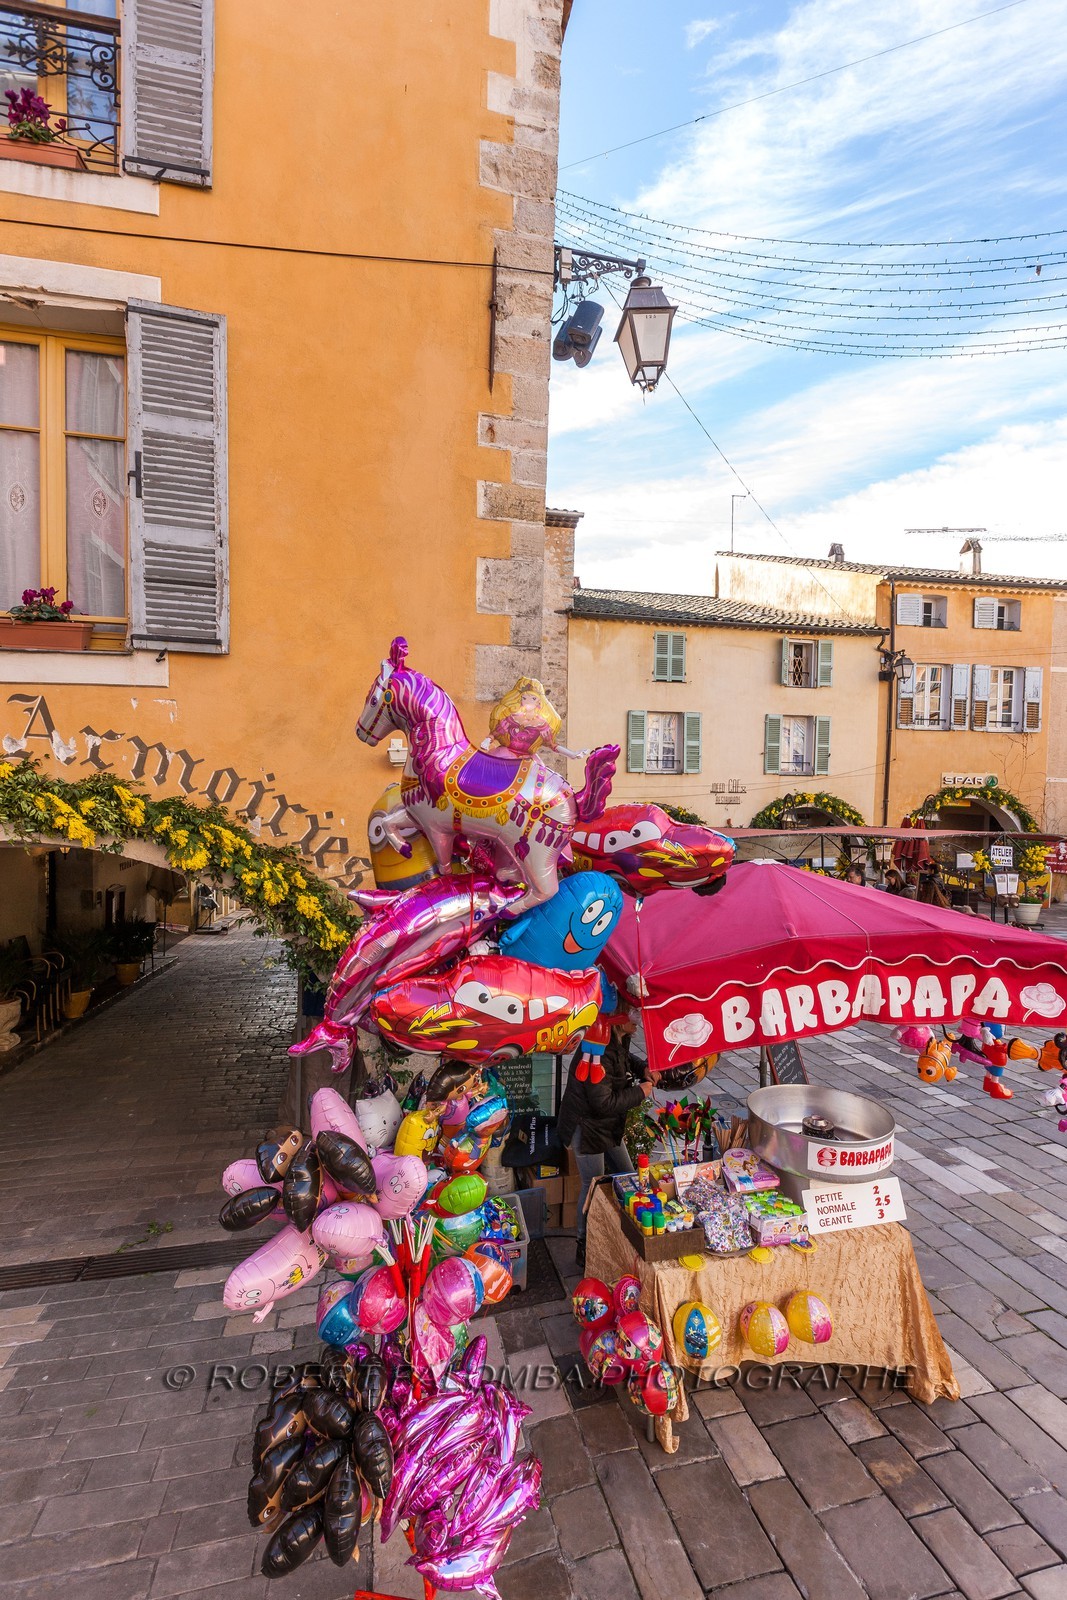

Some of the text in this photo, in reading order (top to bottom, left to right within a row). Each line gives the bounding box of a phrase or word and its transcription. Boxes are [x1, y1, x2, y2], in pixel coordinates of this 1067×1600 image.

[942, 776, 984, 785] SPAR
[1, 693, 373, 889] Armoiries
[721, 974, 1012, 1043] BARBAPAPA
[839, 1142, 892, 1167] BARBAPAPA
[814, 1185, 880, 1204] PETITE 2
[817, 1201, 857, 1216] NORMALE
[818, 1208, 885, 1228] GEANTE 3
